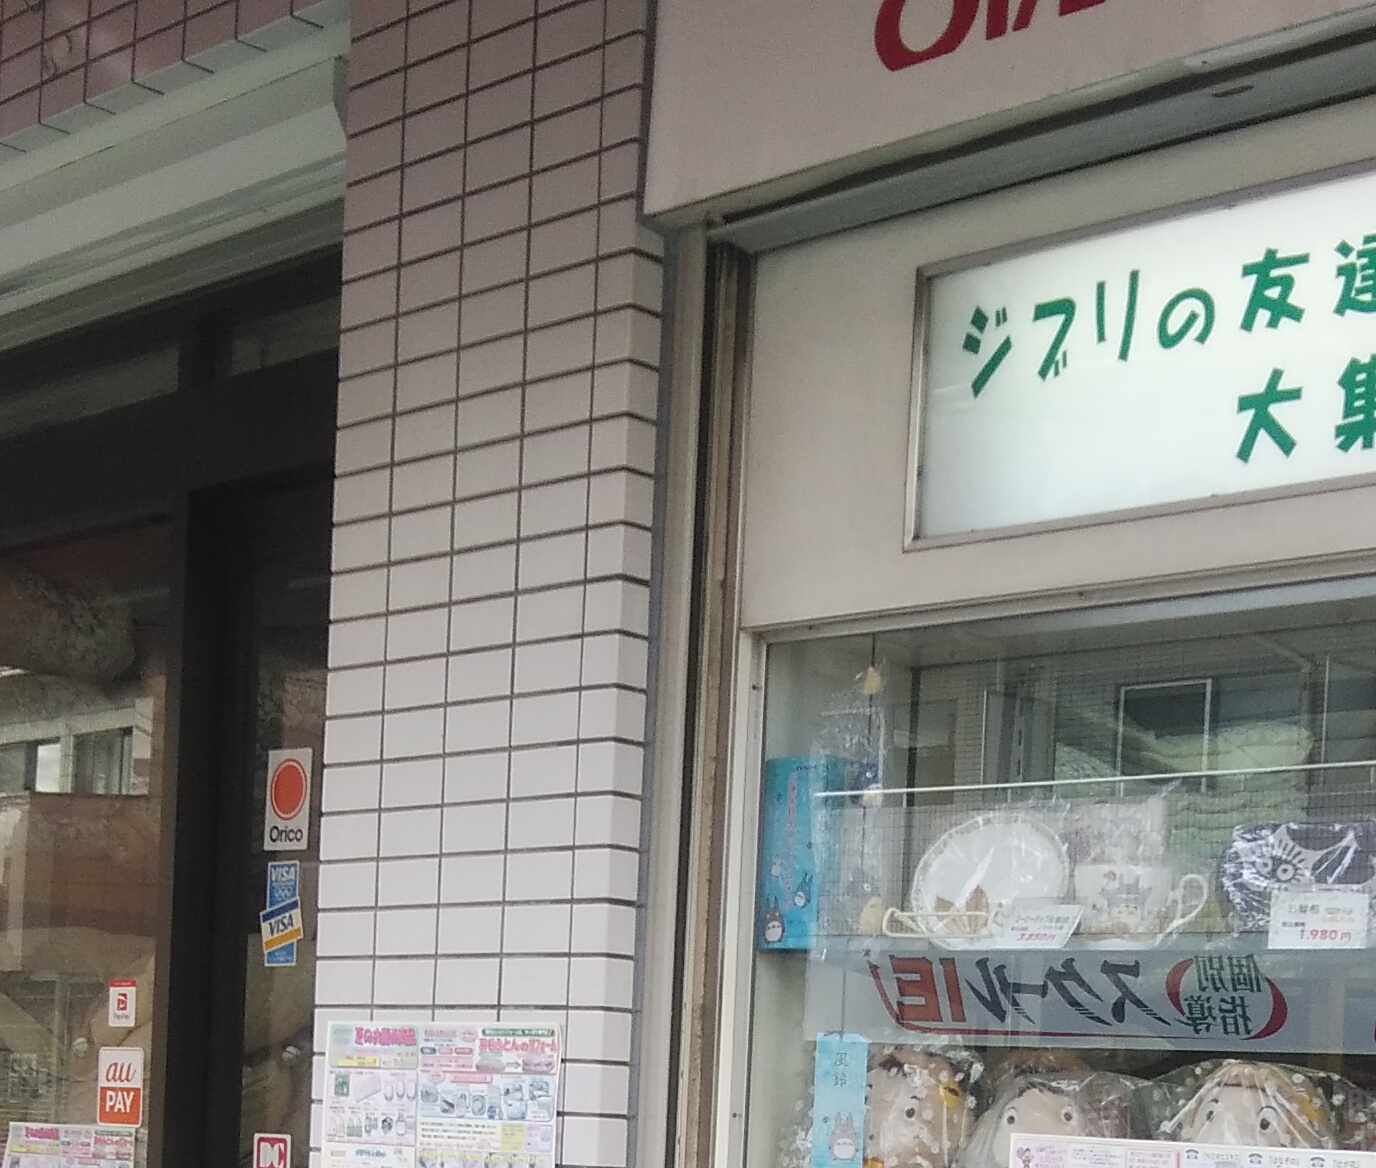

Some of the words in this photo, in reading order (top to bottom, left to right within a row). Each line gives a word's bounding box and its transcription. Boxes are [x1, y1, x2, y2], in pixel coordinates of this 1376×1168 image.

[269, 826, 303, 843] Orico
[271, 866, 295, 882] VISA
[268, 914, 294, 937] VISA
[105, 1061, 136, 1083] au
[832, 1052, 849, 1088] 風鈴
[105, 1091, 134, 1113] PAY
[260, 1142, 284, 1168] DC
